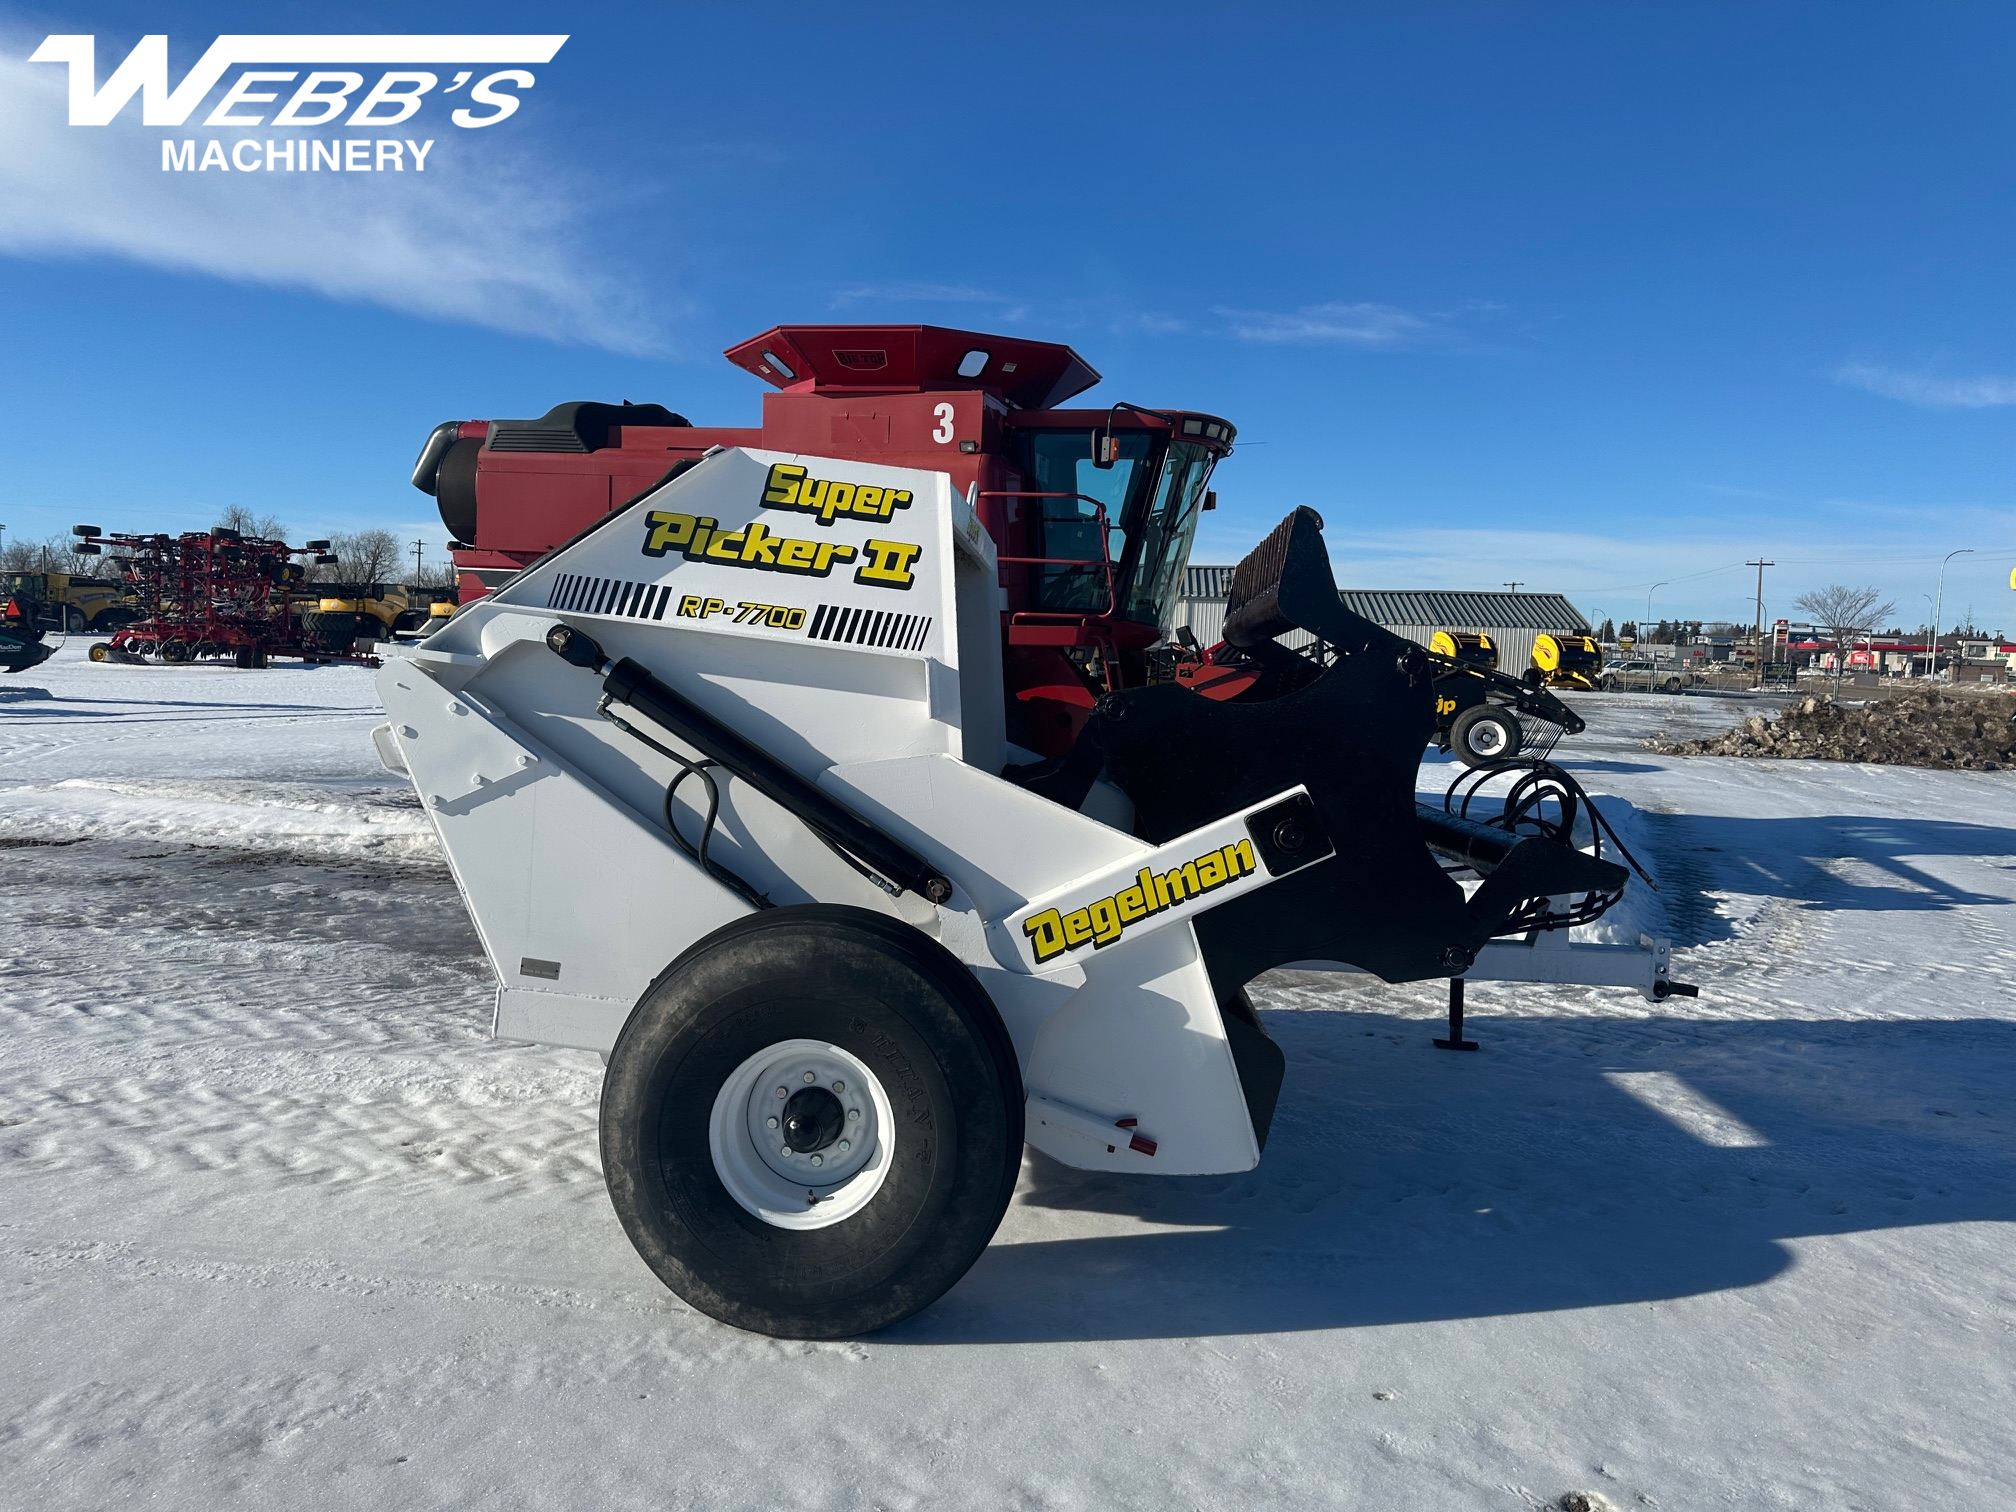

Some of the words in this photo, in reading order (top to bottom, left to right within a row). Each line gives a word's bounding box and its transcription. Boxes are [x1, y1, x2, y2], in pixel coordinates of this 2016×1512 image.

[837, 351, 860, 366] BIG
[860, 351, 886, 366] TOP
[932, 402, 955, 444] 3
[760, 463, 913, 526] Super
[641, 509, 858, 578] Picker
[854, 538, 922, 590] II
[676, 595, 807, 630] RP-7700
[1023, 838, 1258, 965] Degelman
[870, 1030, 934, 1131] TITAN
